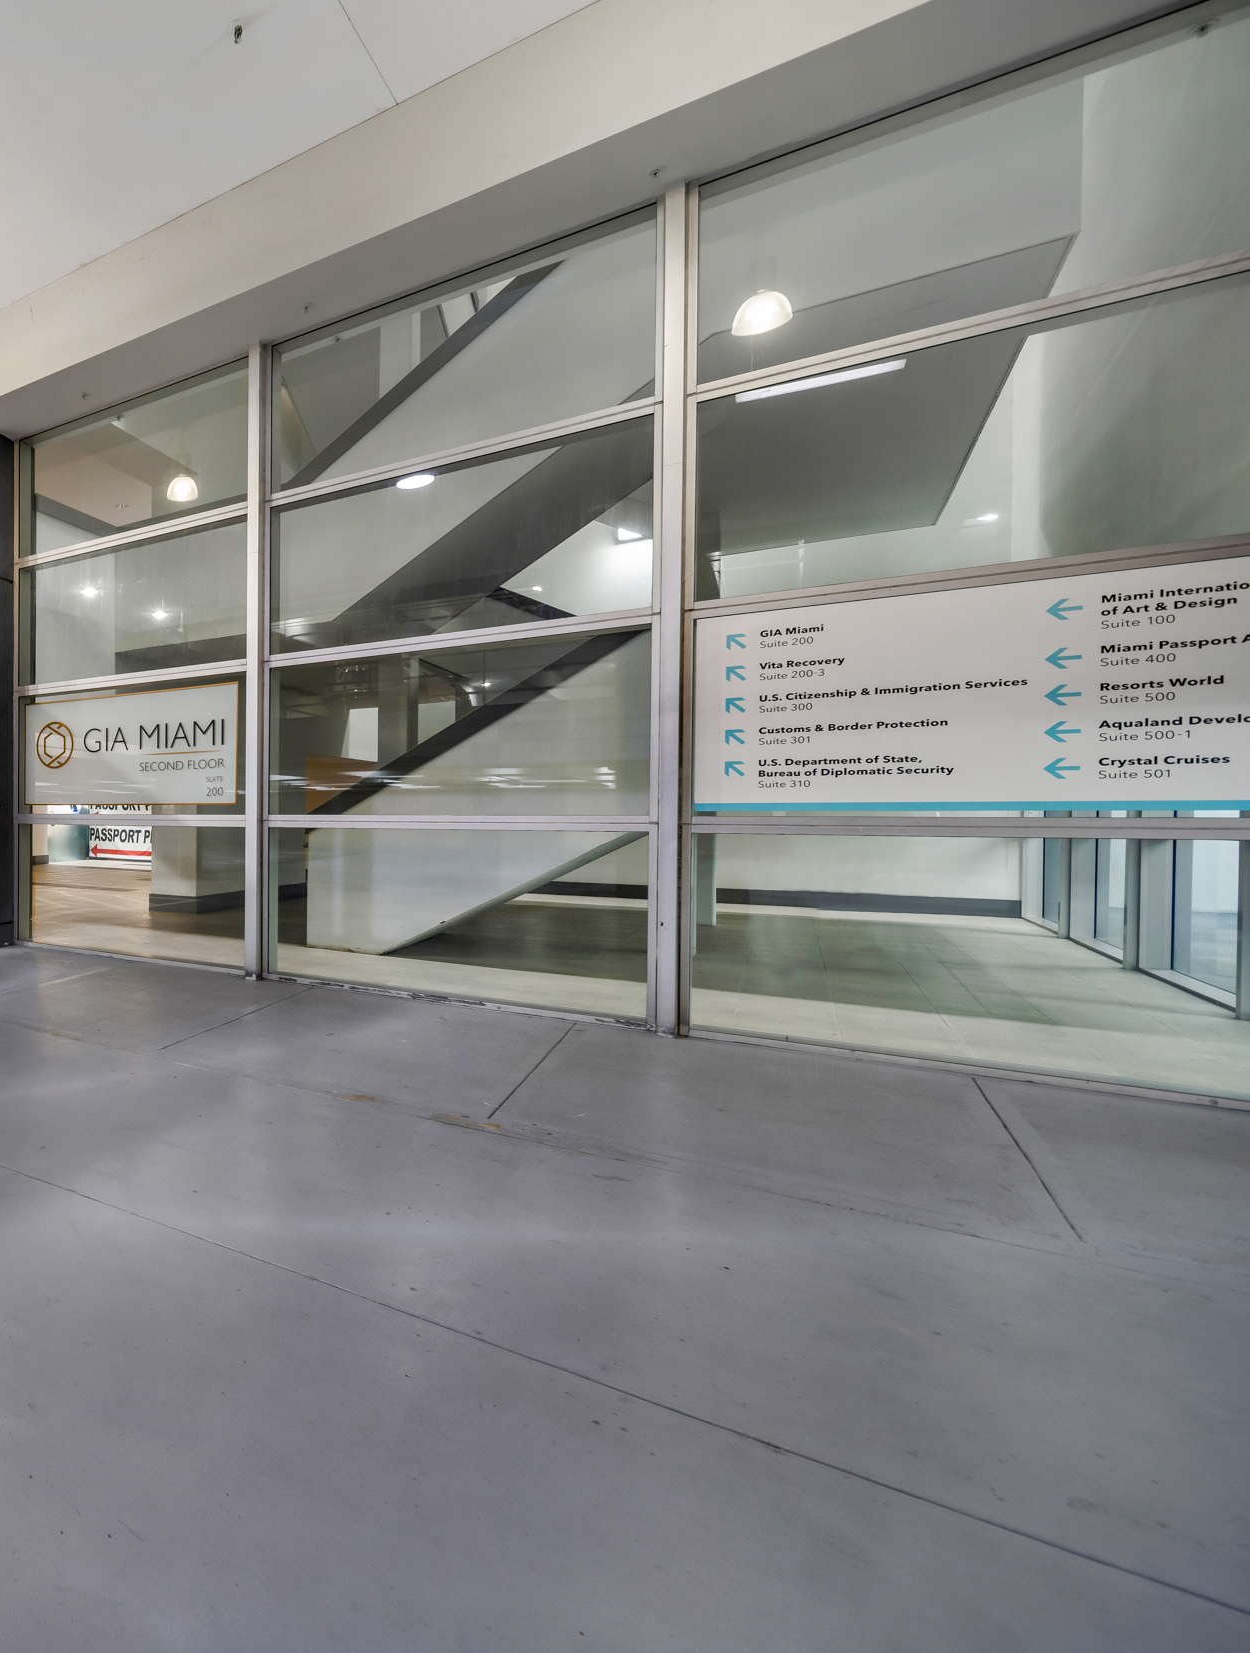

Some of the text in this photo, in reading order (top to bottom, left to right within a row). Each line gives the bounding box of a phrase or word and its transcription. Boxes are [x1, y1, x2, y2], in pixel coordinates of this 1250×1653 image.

[1101, 581, 1250, 603] Miami Internatio
[1101, 597, 1238, 616] of Art & Design
[1101, 614, 1176, 629] Suite 100
[760, 624, 824, 638] GIA Miami
[760, 636, 814, 648] Suite 200
[1101, 642, 1153, 654] Miami
[1159, 636, 1237, 649] Passport
[760, 656, 845, 670] Vita Recovery
[1100, 653, 1176, 667] Suite 400
[759, 668, 825, 681] Suite 200-3
[759, 678, 1028, 702] U.S. Citizenship & Immigration Services
[1100, 675, 1224, 691] Resorts World
[1100, 692, 1176, 704] Suite 500
[759, 702, 813, 714] Suite 300
[759, 718, 948, 734] Customs & Border Protection
[1099, 716, 1182, 730] Aqualand
[83, 719, 225, 753] GIA MIAMI
[758, 736, 811, 745] Suite 301
[1099, 730, 1191, 742] Suite 500-1
[139, 757, 225, 772] SECOND FLOOR
[758, 754, 922, 767] U.S. Department of State,
[1099, 755, 1230, 768] Crystal Cruises
[758, 764, 954, 778] Bureau of Diplomatic Security
[1099, 769, 1170, 779] Suite 501
[206, 775, 224, 783] SUITE
[758, 780, 810, 788] Suite 310
[206, 787, 224, 797] 200
[90, 828, 141, 843] PASSPORT
